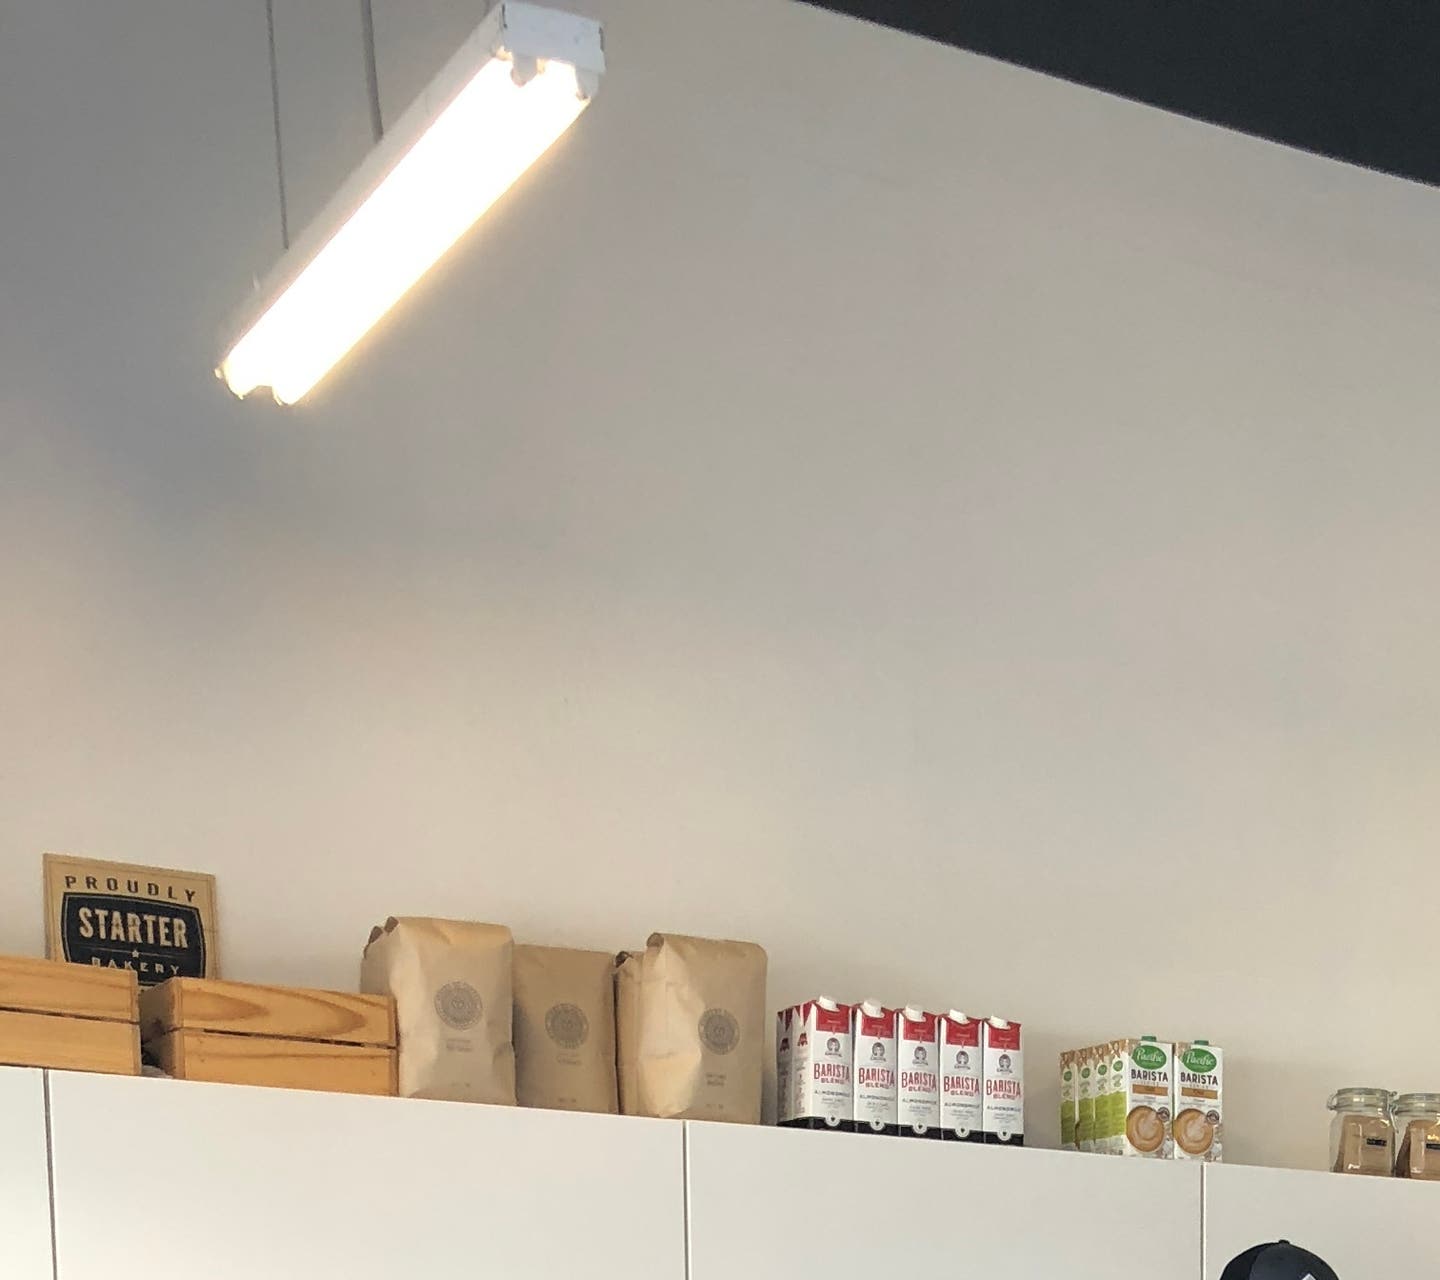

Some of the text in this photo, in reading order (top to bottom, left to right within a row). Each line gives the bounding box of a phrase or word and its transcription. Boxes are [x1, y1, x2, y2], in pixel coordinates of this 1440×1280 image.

[65, 876, 196, 902] PROUDLY
[78, 907, 188, 949] STARTER
[814, 1063, 850, 1081] BARISTA
[859, 1067, 895, 1087] BARISTA
[901, 1071, 937, 1091] BARISTA
[1131, 1069, 1169, 1082] BARISTA
[1181, 1072, 1218, 1086] BARISTA
[943, 1075, 980, 1094] BARISTA
[986, 1079, 1021, 1099] BARISTA
